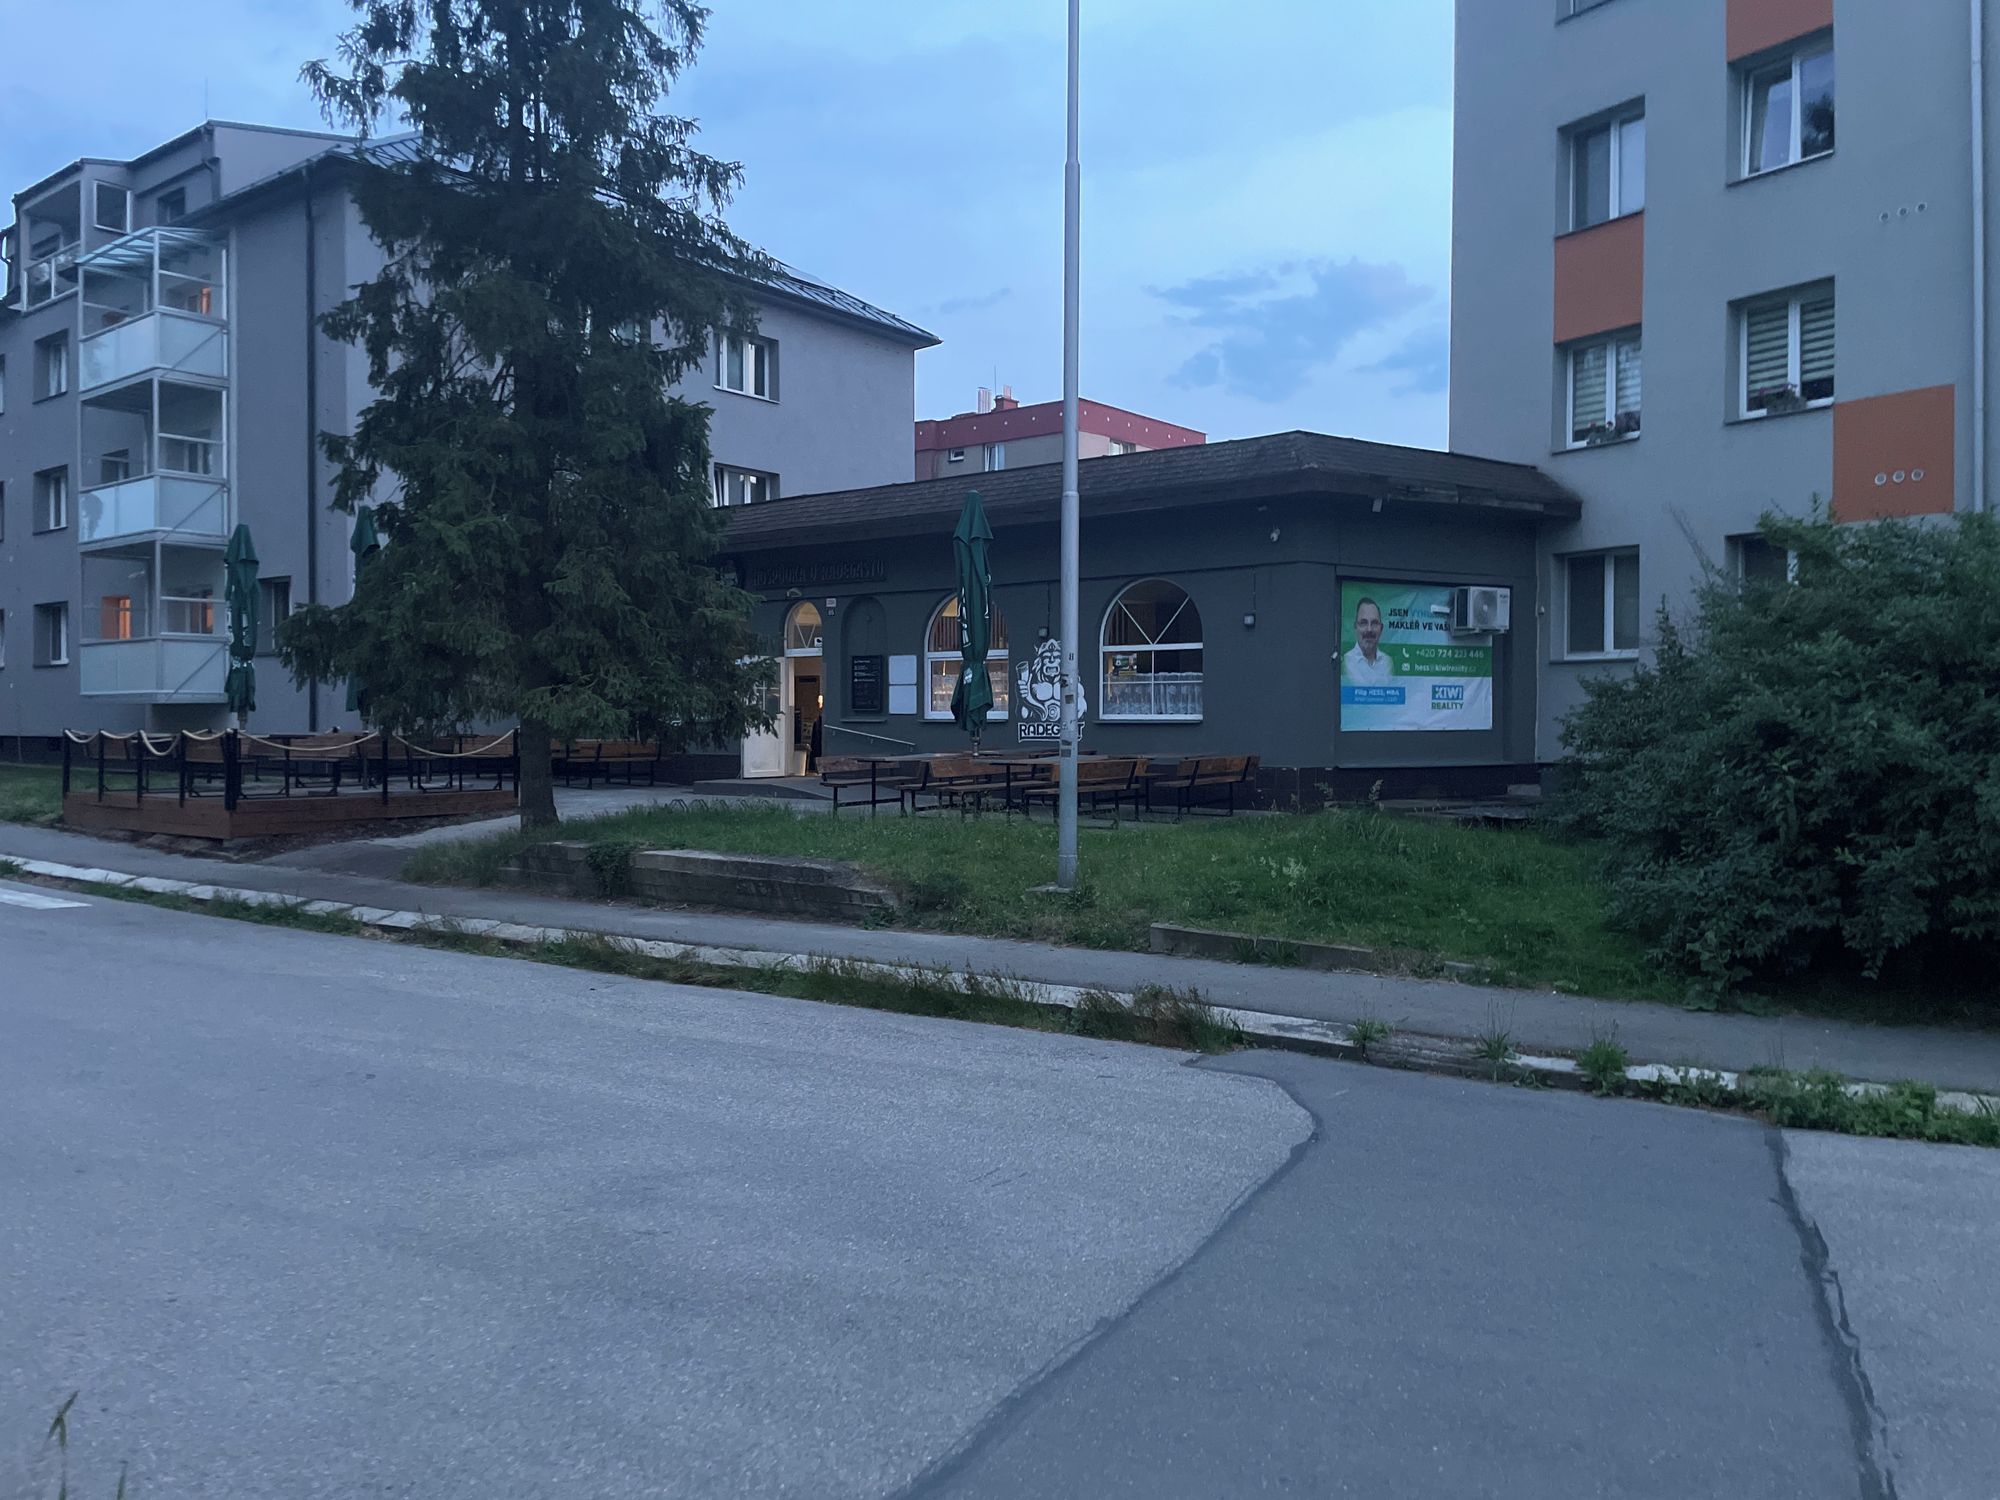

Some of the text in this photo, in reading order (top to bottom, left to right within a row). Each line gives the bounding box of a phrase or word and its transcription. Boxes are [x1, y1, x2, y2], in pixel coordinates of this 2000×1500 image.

[1422, 622, 1433, 631] VE
[1434, 687, 1463, 699] KIWI
[1431, 702, 1464, 710] REALITY
[1019, 722, 1084, 738] RADEGT
